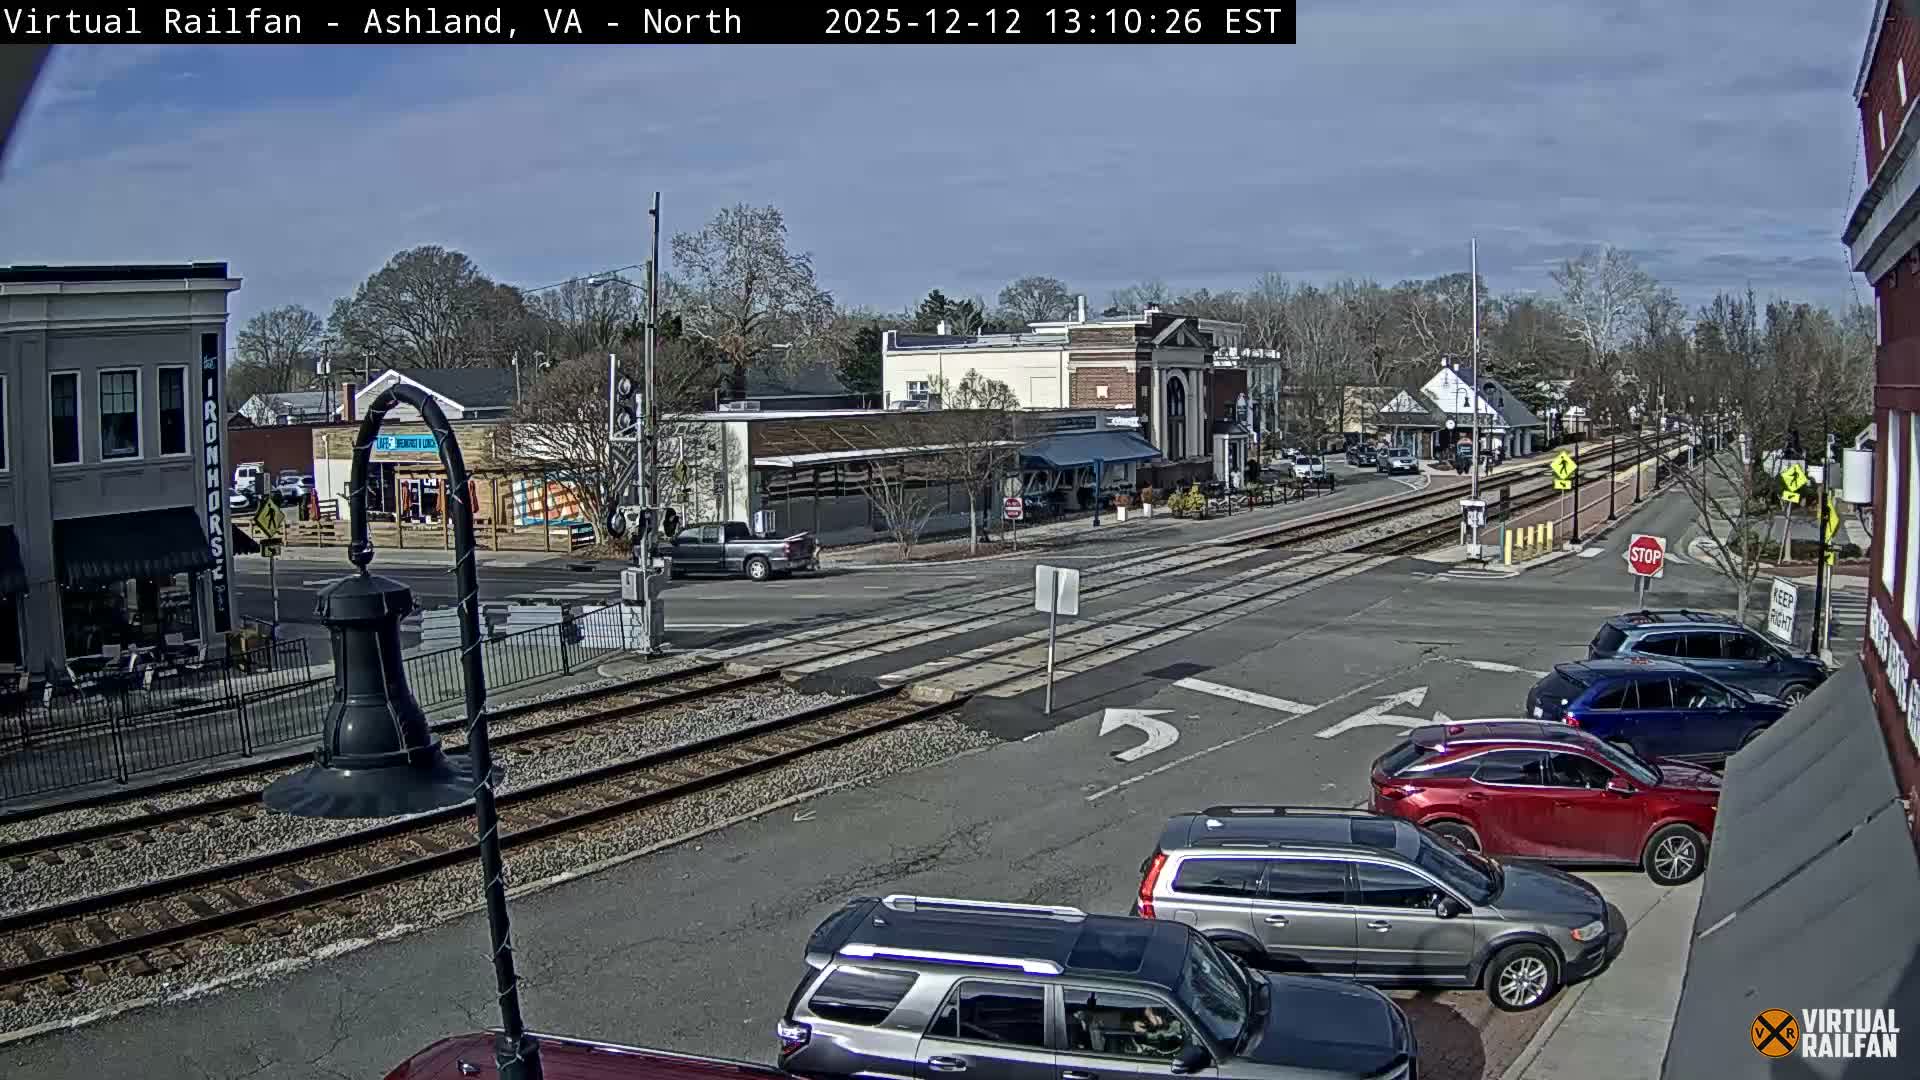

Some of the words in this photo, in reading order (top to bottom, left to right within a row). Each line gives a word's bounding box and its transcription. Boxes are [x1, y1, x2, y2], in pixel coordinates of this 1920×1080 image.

[1631, 547, 1662, 565] STOP
[1774, 587, 1794, 609] KEEP
[1770, 608, 1793, 633] RIGHT
